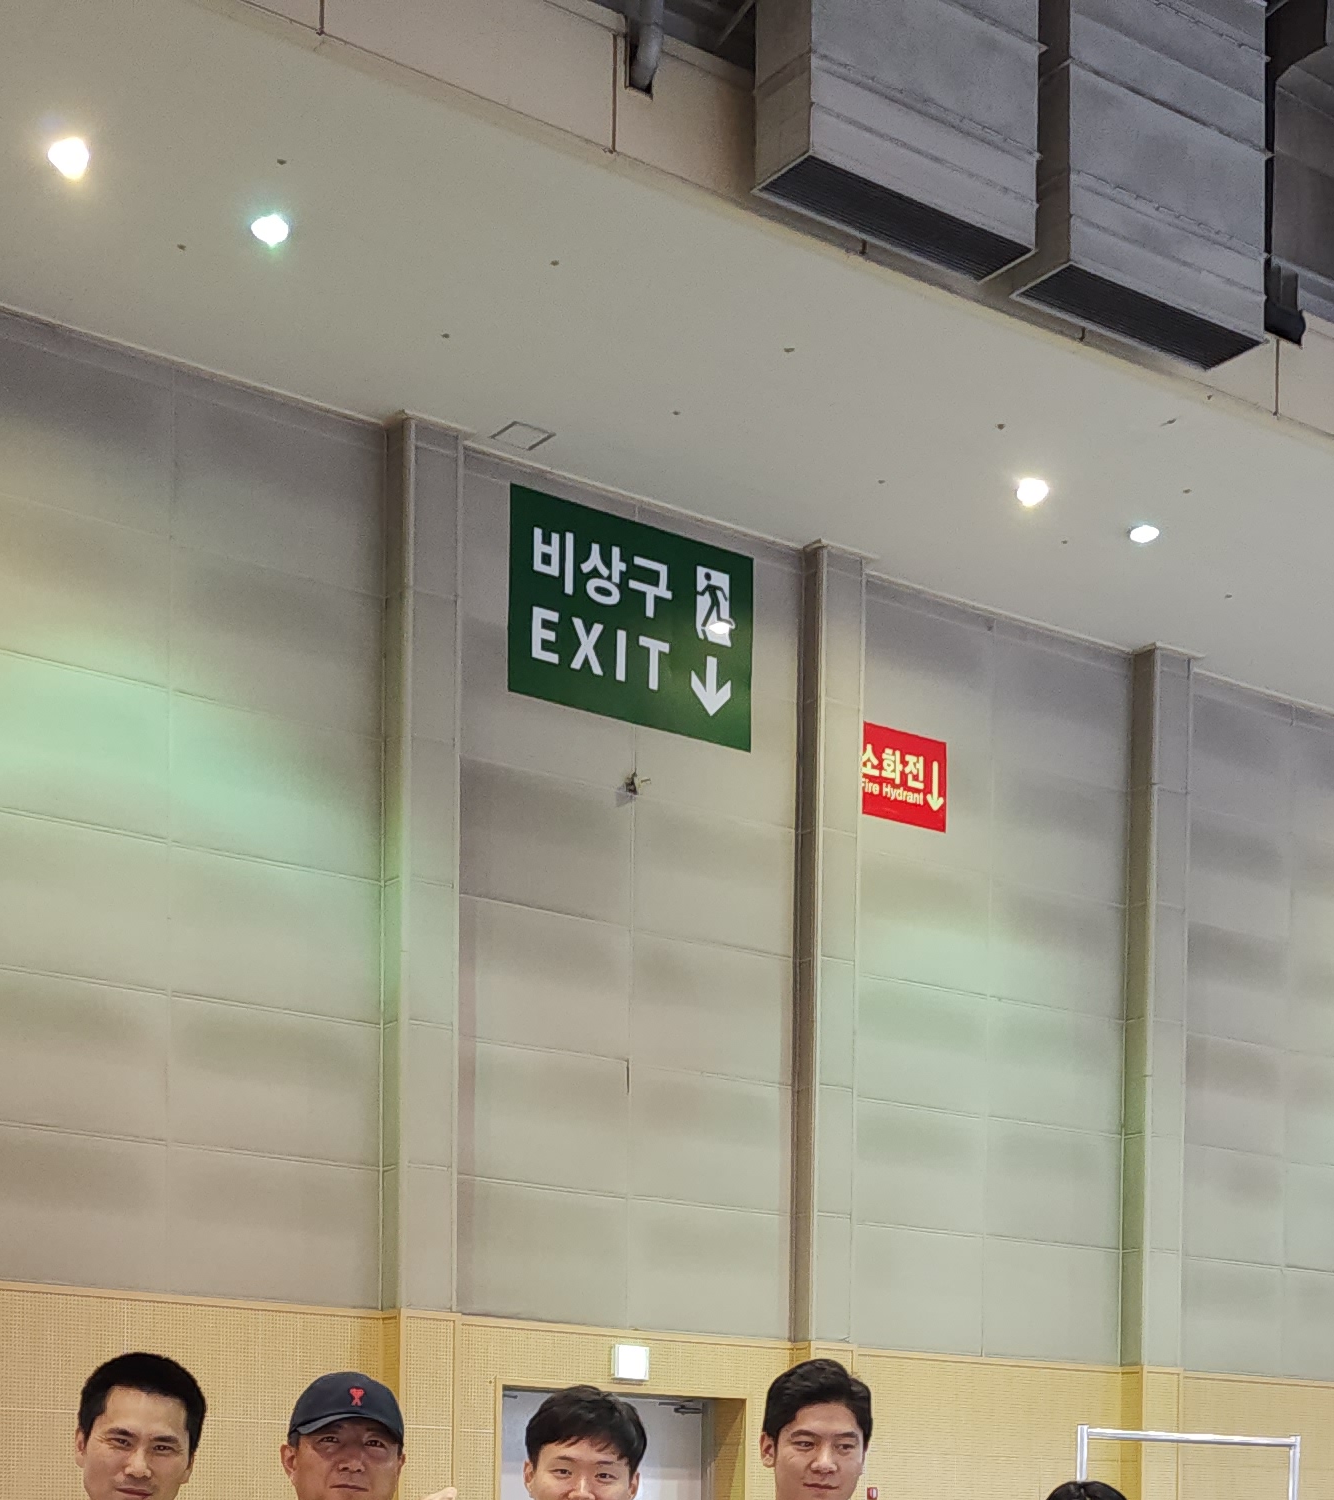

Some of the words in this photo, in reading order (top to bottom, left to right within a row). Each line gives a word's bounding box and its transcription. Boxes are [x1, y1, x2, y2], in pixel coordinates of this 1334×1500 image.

[532, 525, 673, 620] 비상구
[530, 605, 671, 692] EXIT
[862, 743, 925, 790] 소화전
[882, 782, 924, 806] Hydrant
